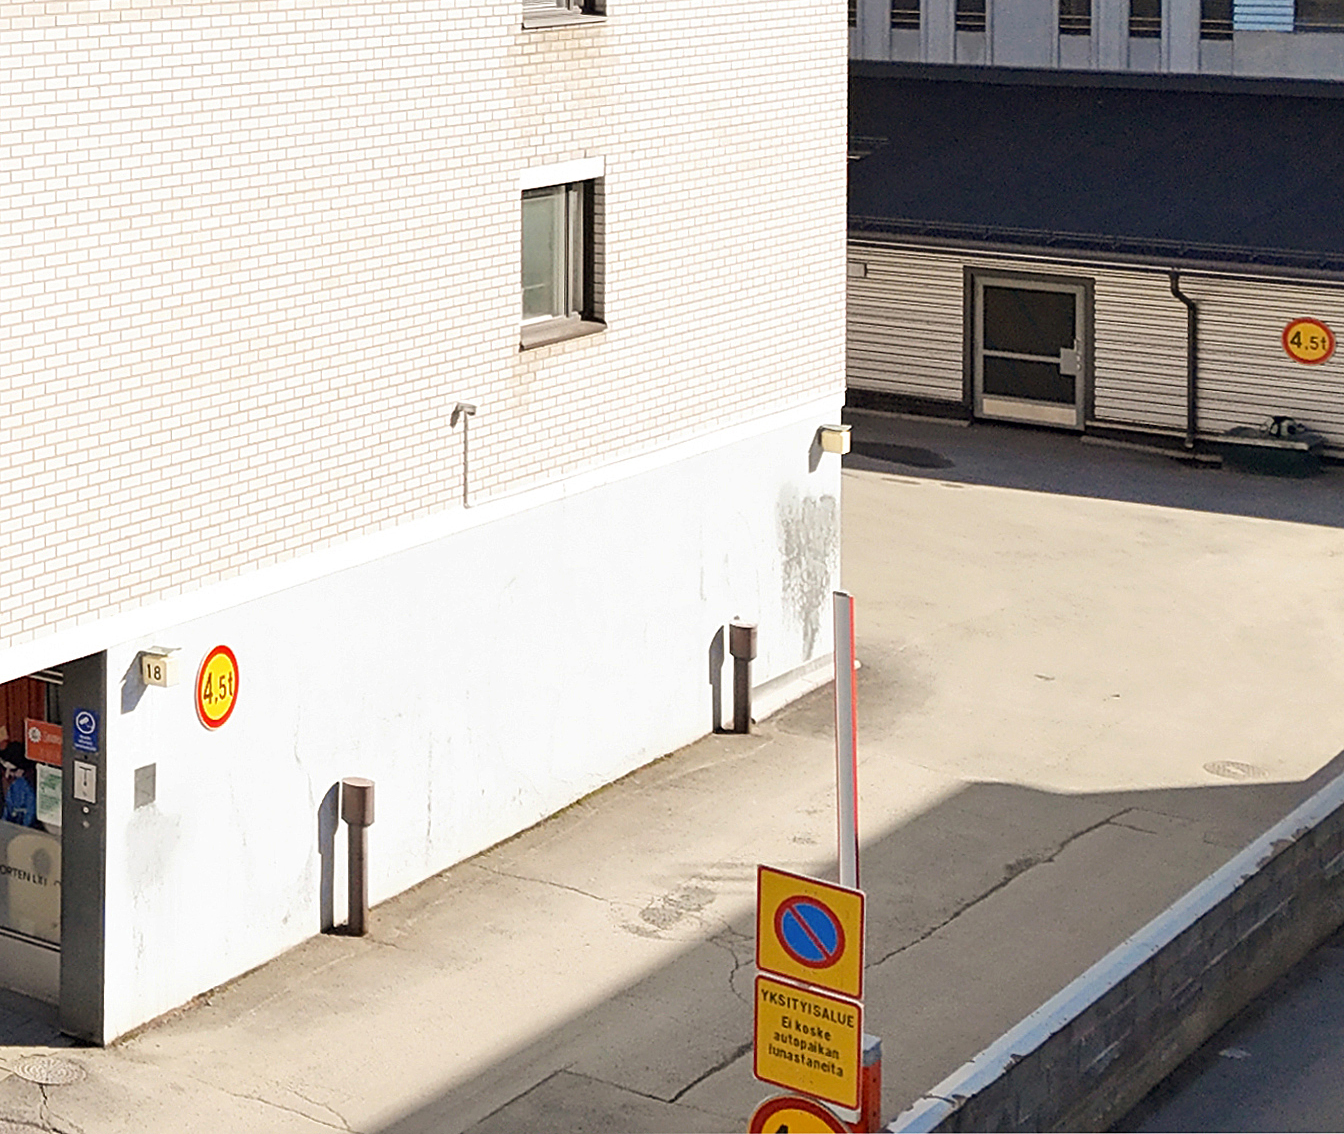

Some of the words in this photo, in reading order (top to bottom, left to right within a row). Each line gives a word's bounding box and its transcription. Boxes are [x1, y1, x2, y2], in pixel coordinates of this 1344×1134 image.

[146, 663, 162, 681] 18
[203, 671, 234, 705] 4,5t
[761, 988, 855, 1029] YKSITYISALUE
[781, 1015, 792, 1030] Ei
[795, 1019, 832, 1042] koske
[768, 1044, 844, 1078] lunastaneita
[773, 1031, 840, 1061] autopaikan
